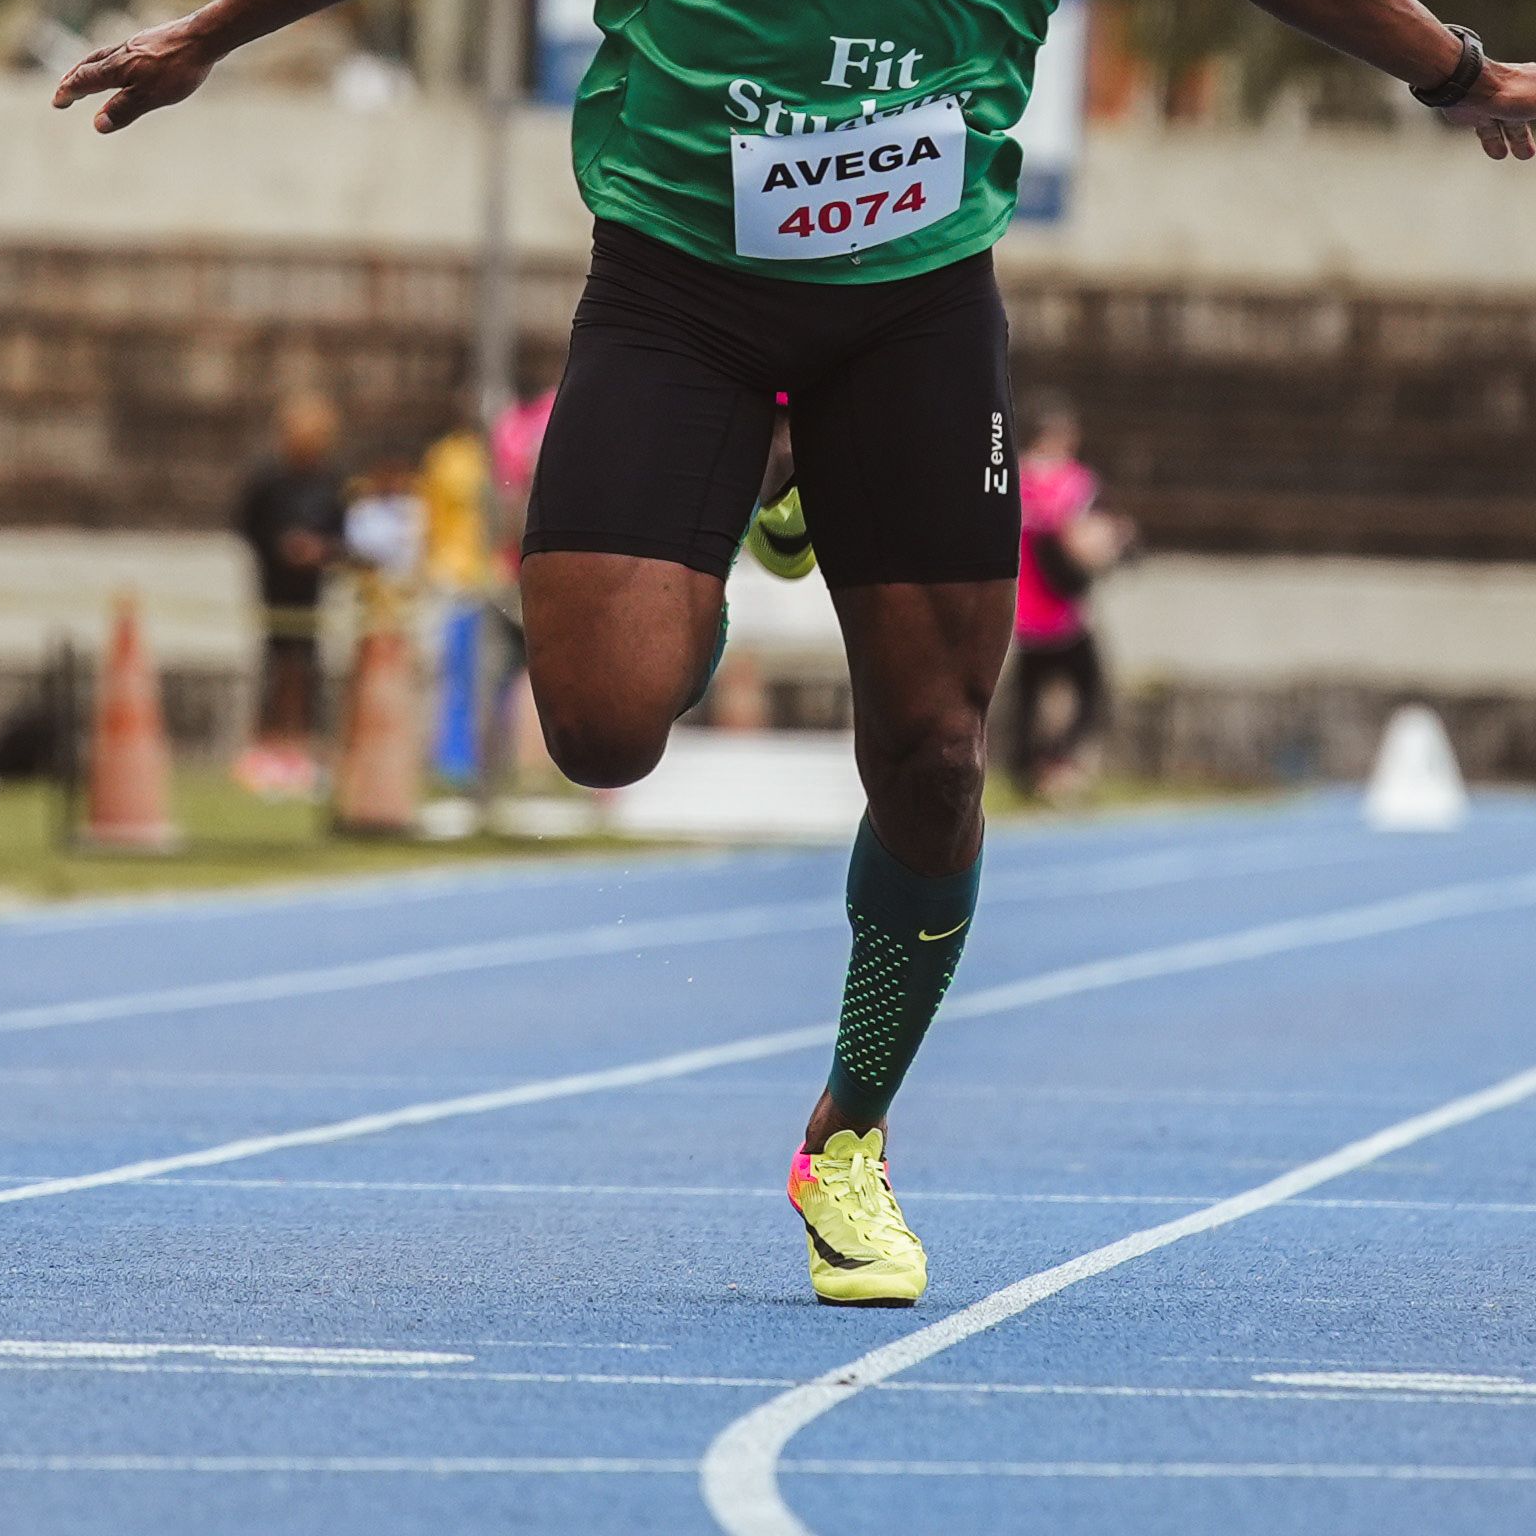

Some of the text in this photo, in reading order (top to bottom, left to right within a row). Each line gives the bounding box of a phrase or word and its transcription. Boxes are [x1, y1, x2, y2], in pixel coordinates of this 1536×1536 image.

[820, 35, 924, 91] Fit
[761, 135, 941, 193] AVEGA
[778, 181, 927, 238] 4074
[990, 411, 1004, 466] evus
